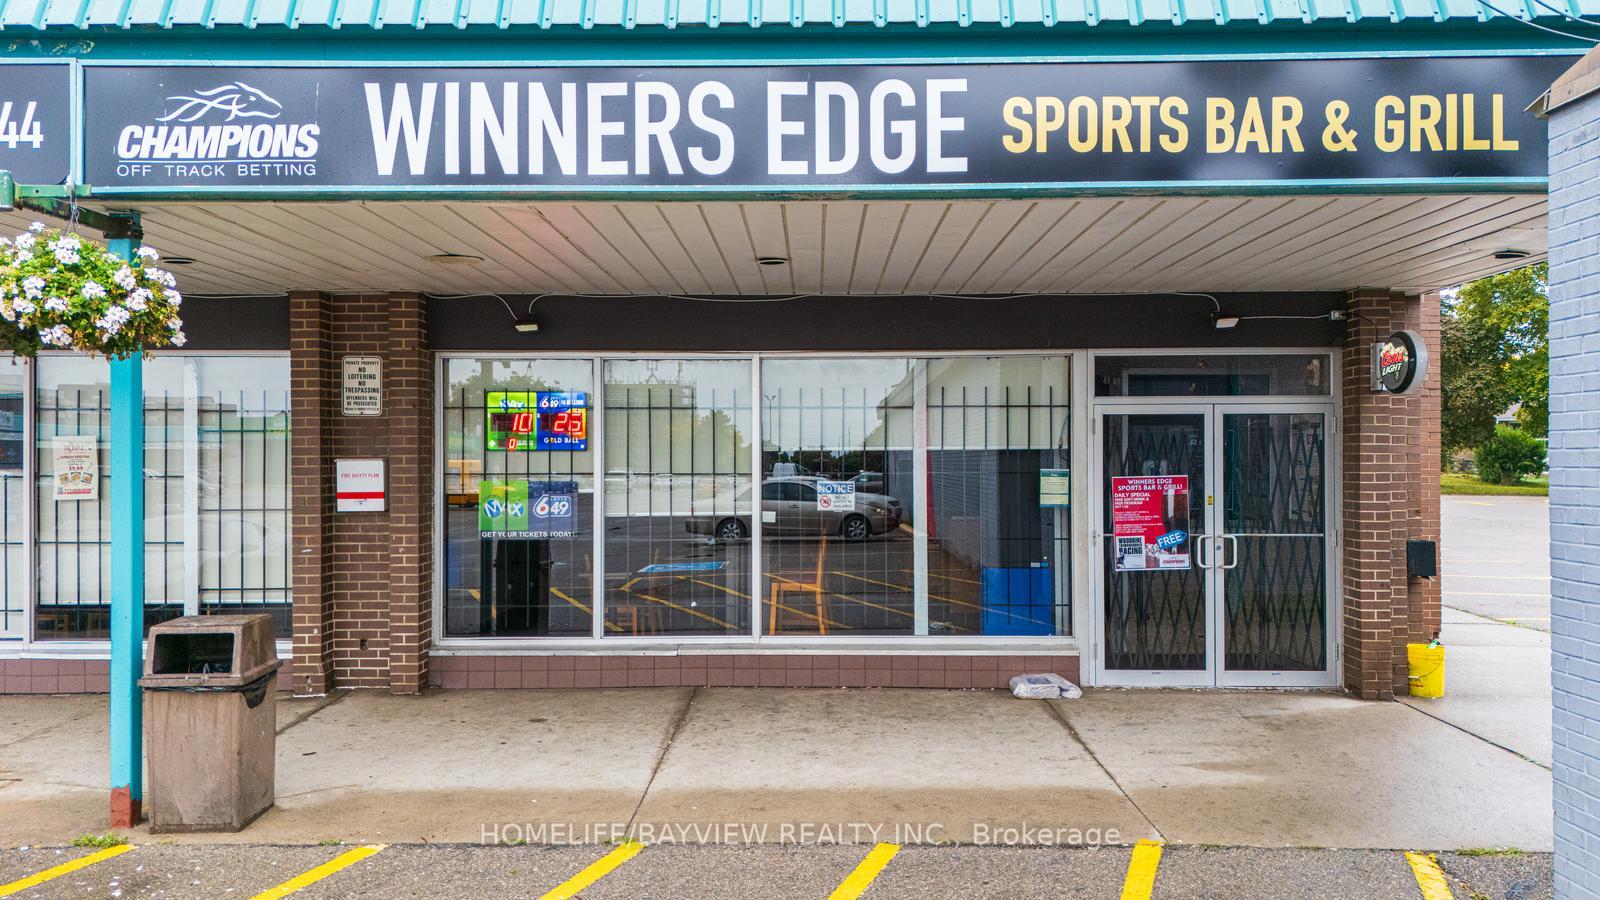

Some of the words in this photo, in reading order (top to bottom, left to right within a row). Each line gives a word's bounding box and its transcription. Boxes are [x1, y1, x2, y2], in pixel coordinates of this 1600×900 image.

[364, 81, 736, 175] WINNERS
[767, 78, 968, 175] EDGE
[1002, 95, 1189, 154] SPORTS
[1206, 96, 1305, 154] BAR
[1322, 99, 1358, 152] &
[1374, 93, 1520, 152] GRILL
[117, 123, 320, 159] CHAMPIONS
[116, 165, 152, 177] OFF
[164, 164, 225, 177] TRACK
[237, 164, 316, 176] BETTING
[1382, 362, 1402, 376] LIGHT
[513, 413, 533, 432] 10
[554, 413, 582, 432] 25
[508, 438, 516, 449] 0
[818, 484, 853, 493] NOTICE
[1157, 532, 1183, 548] FREE
[1119, 547, 1143, 555] RACING
